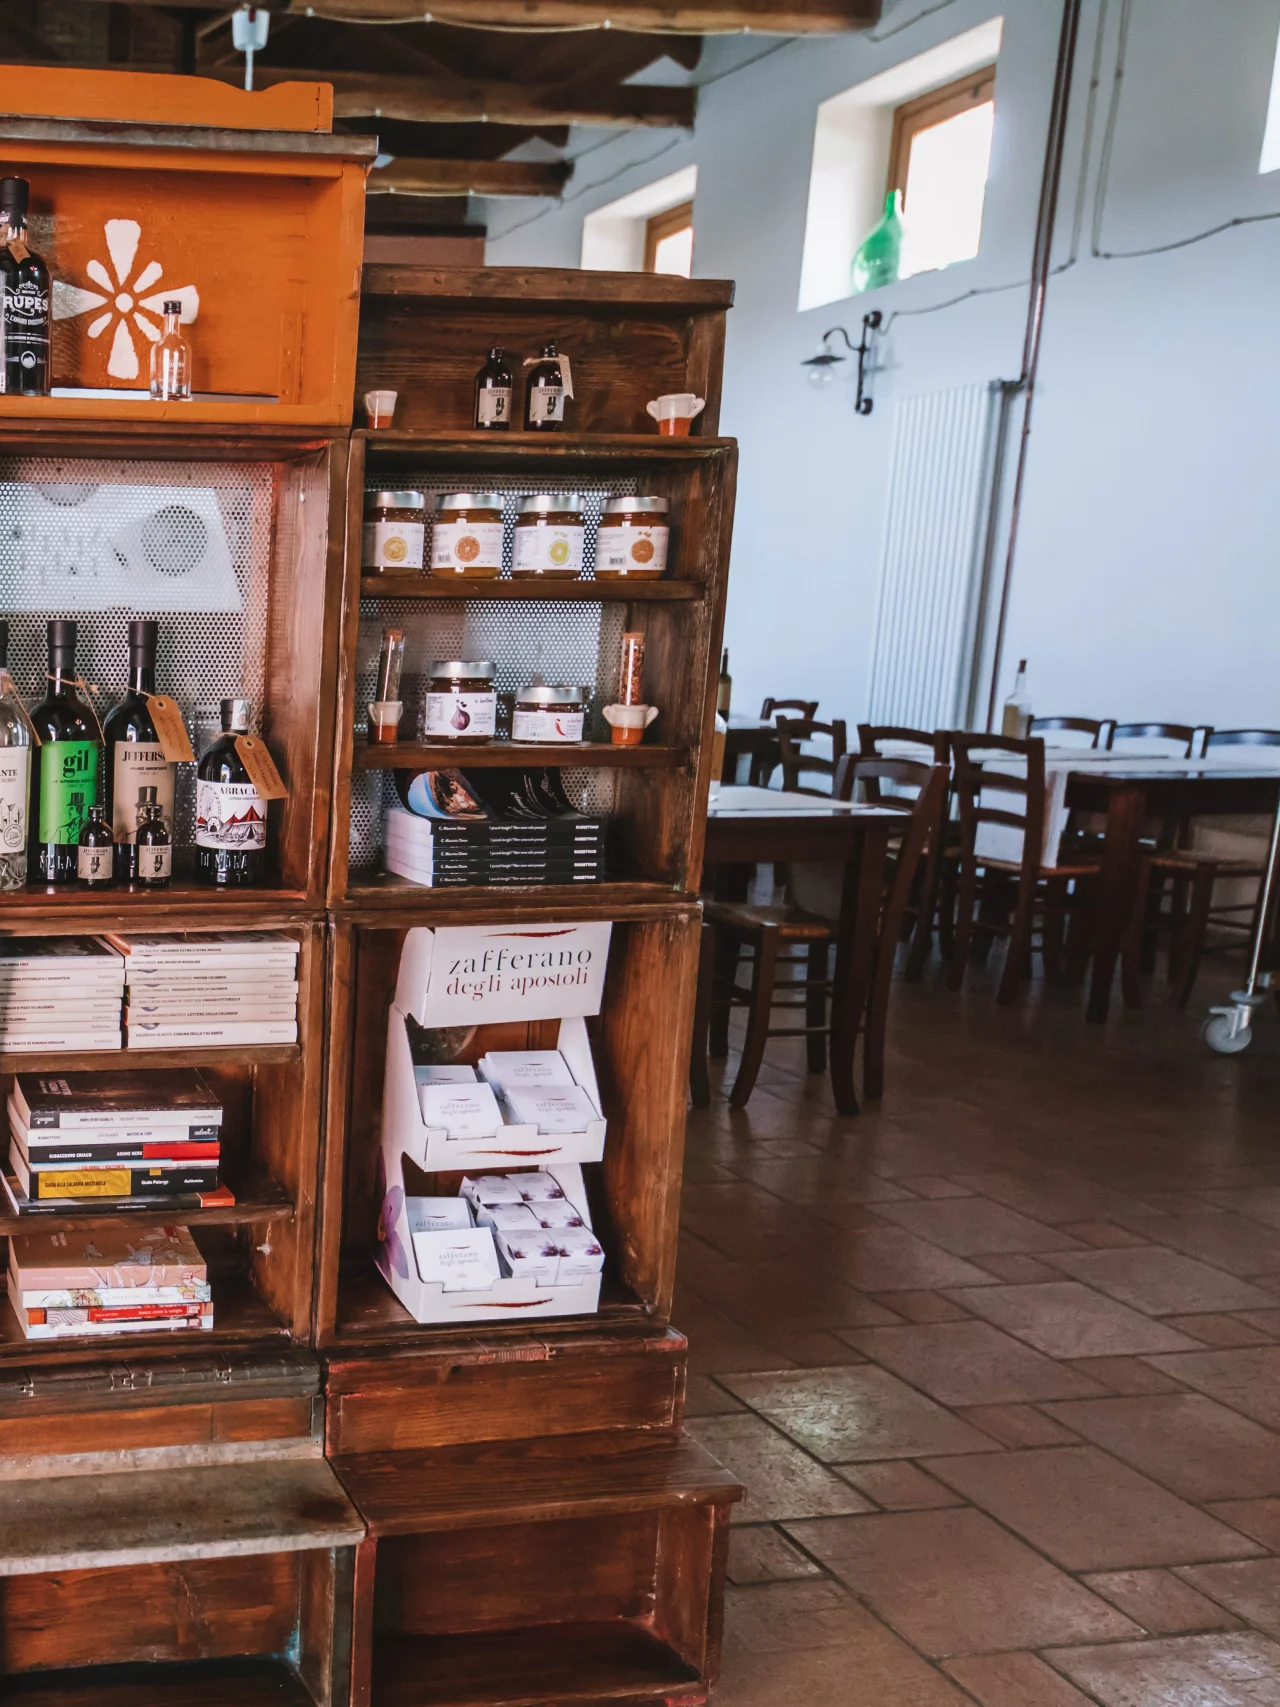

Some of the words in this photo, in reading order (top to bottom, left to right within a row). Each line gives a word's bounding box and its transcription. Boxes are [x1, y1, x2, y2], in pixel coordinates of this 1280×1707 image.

[2, 295, 49, 311] RUPES
[62, 749, 89, 779] gil
[122, 751, 166, 762] JEFFERS
[449, 949, 592, 975] zafferano
[446, 974, 501, 1001] degli
[510, 966, 588, 996] apostoli
[440, 1102, 480, 1110] zafferano
[439, 1251, 478, 1260] zafferano
